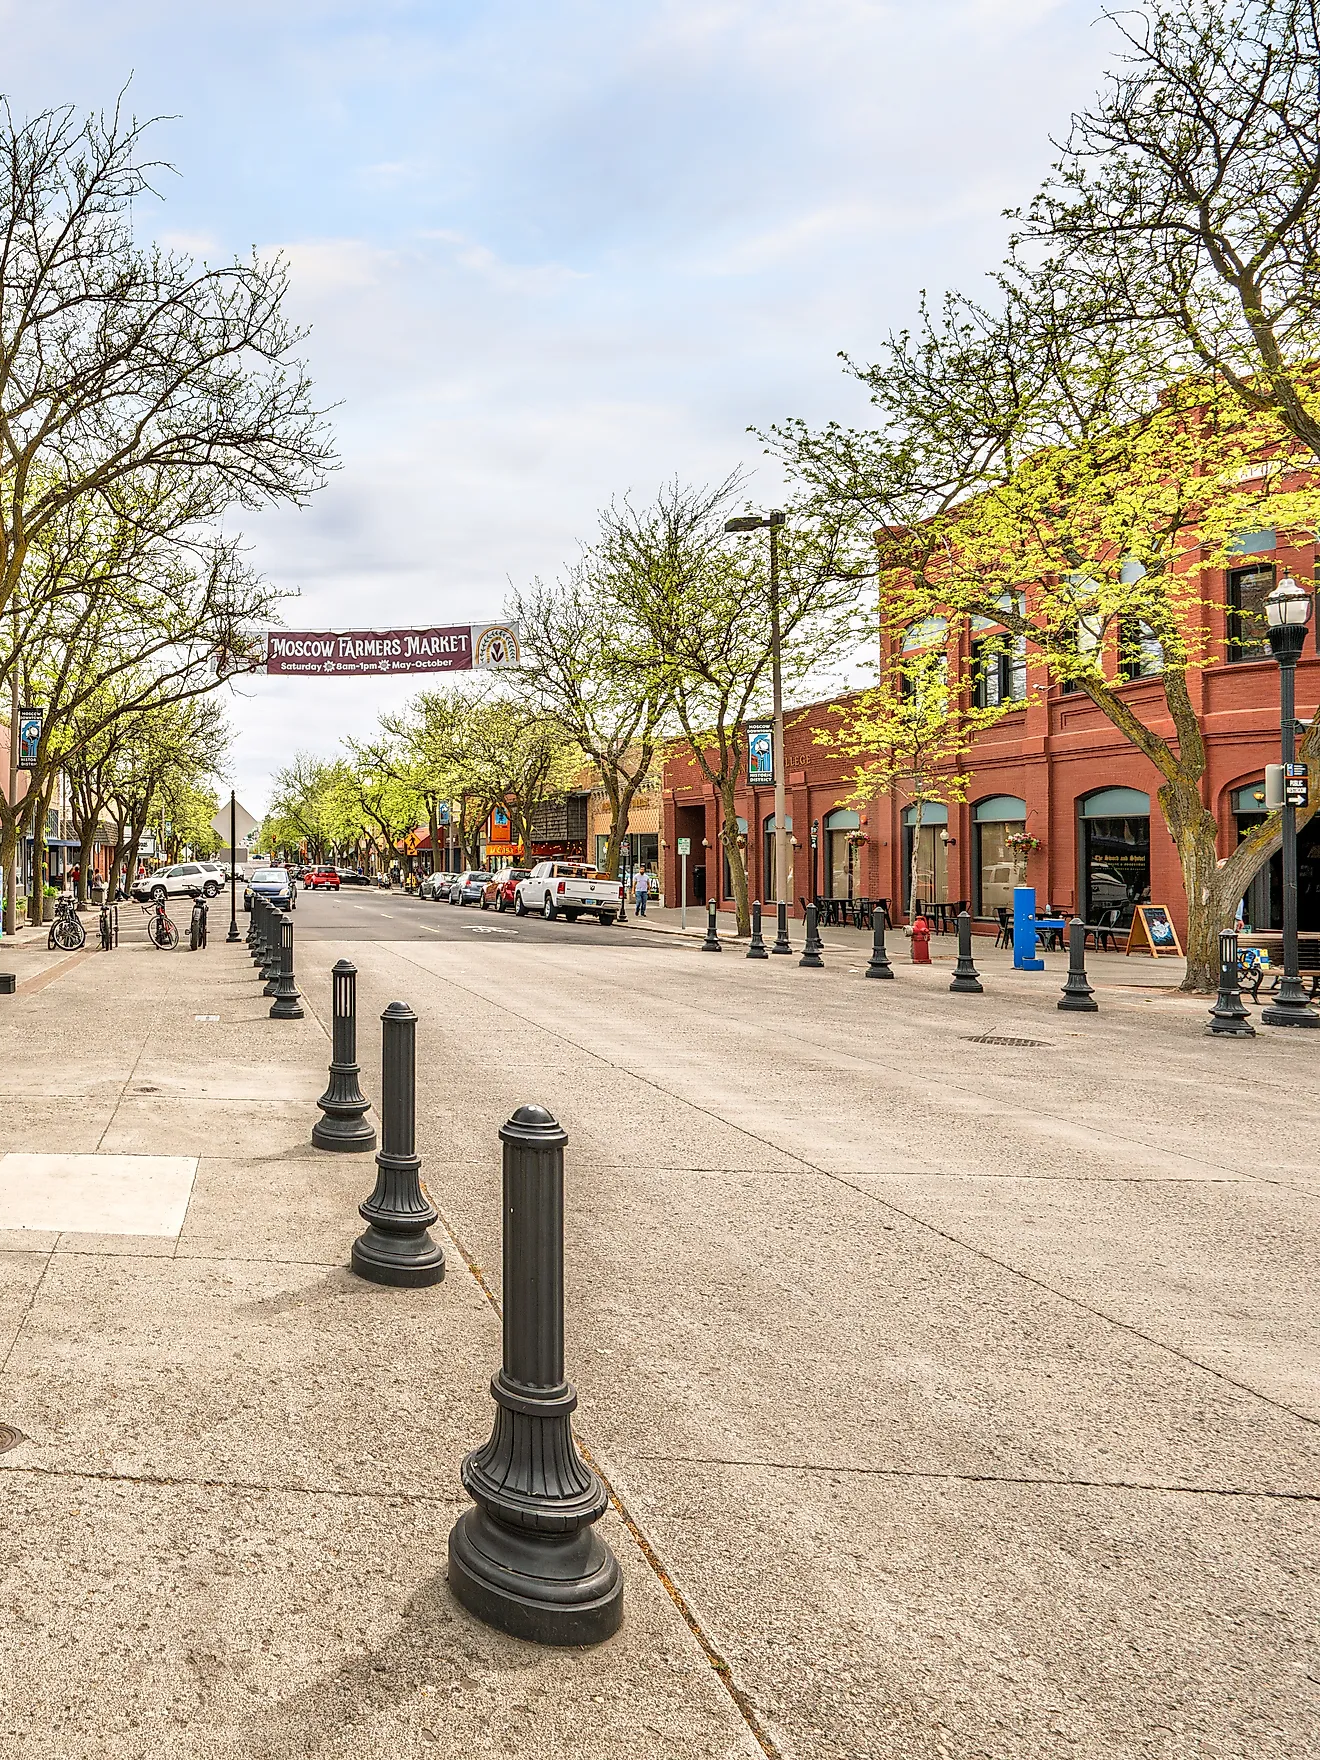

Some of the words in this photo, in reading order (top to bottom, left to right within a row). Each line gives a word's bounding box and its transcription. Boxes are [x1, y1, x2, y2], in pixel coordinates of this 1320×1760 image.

[271, 638, 336, 659] MOSCOW
[337, 636, 402, 659] FARMERS
[404, 634, 469, 657] MARKET
[281, 662, 322, 673] Saturday
[336, 662, 378, 672] 8am-1pm
[392, 659, 453, 671] May-October
